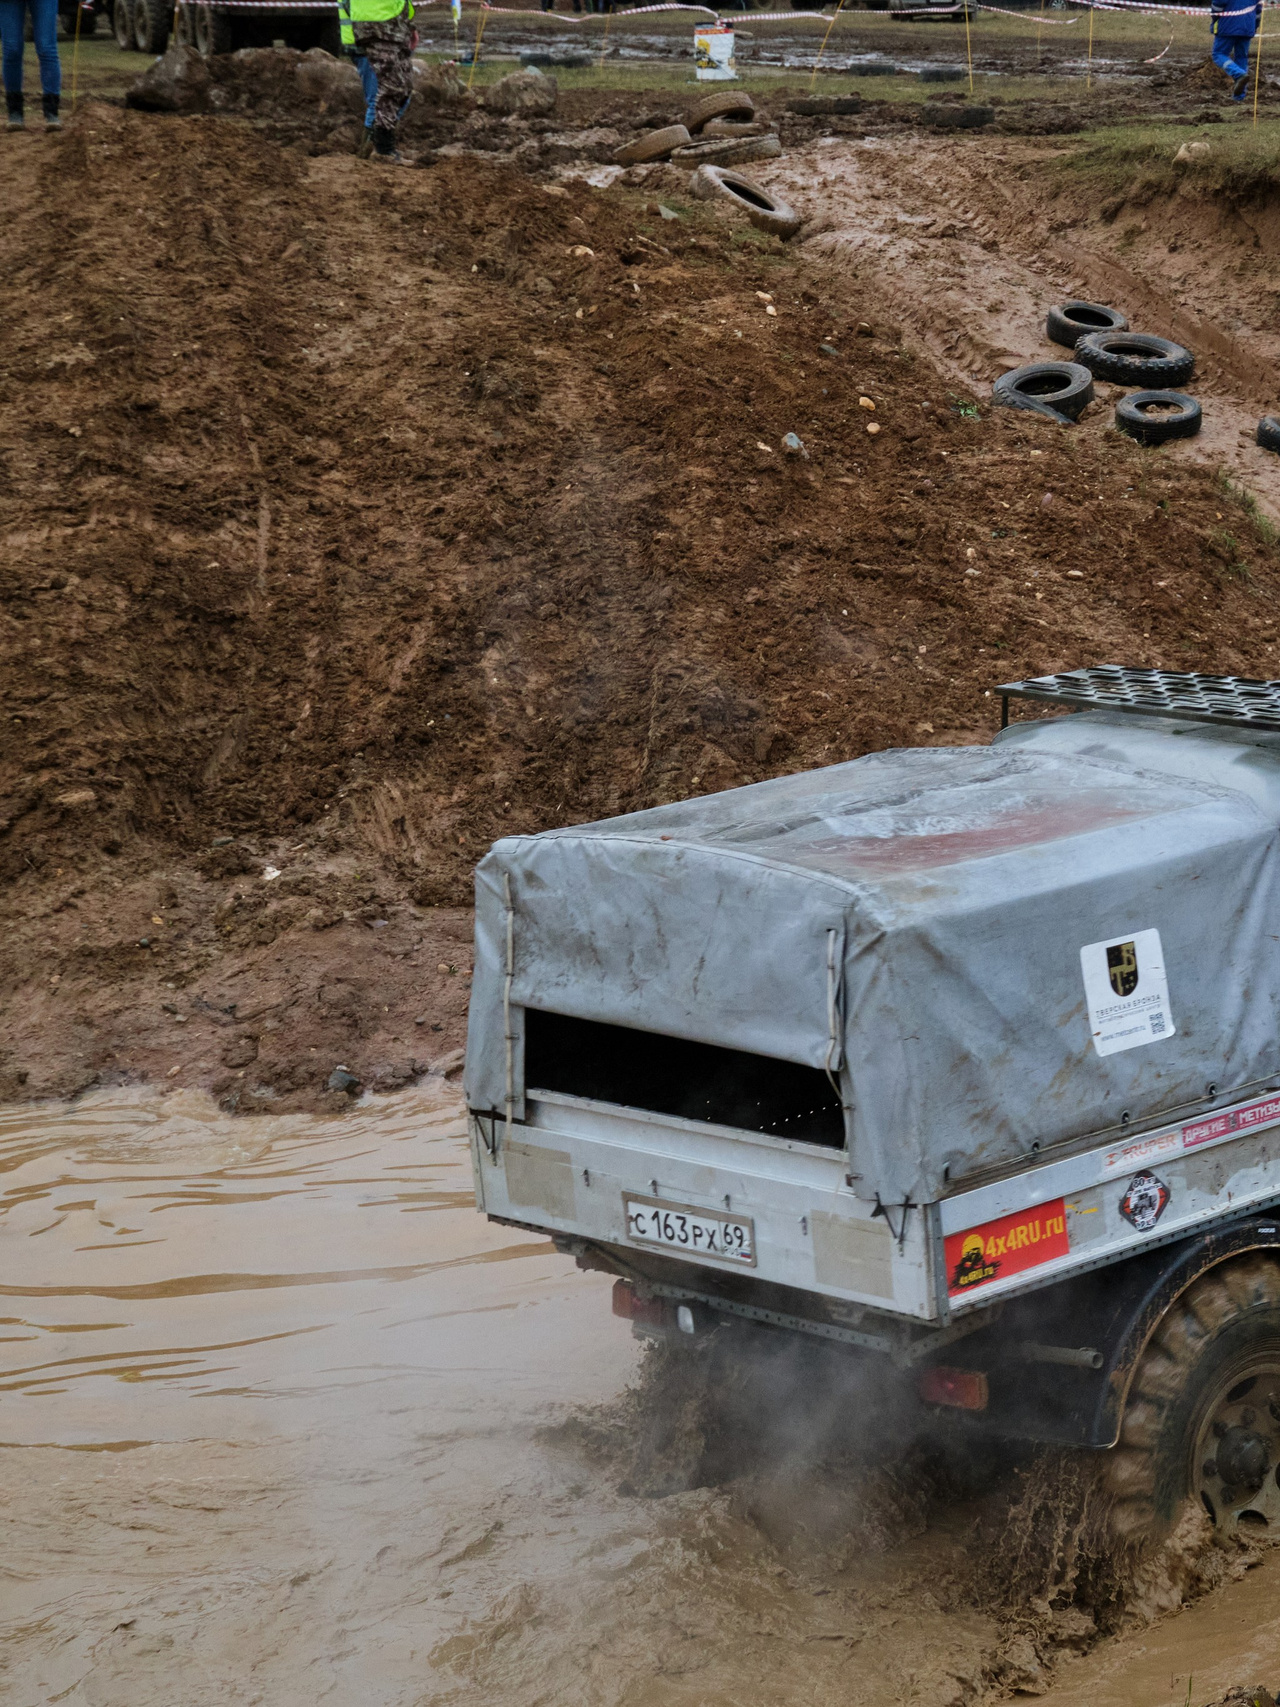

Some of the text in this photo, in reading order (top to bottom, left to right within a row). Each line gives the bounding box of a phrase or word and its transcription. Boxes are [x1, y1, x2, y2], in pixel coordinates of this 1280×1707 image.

[1184, 1119, 1226, 1144] ДРУГИЕ
[723, 1223, 744, 1248] 69
[985, 1215, 1064, 1258] 4x4RU.ru
[958, 1266, 995, 1285] 4x4RU.ru
